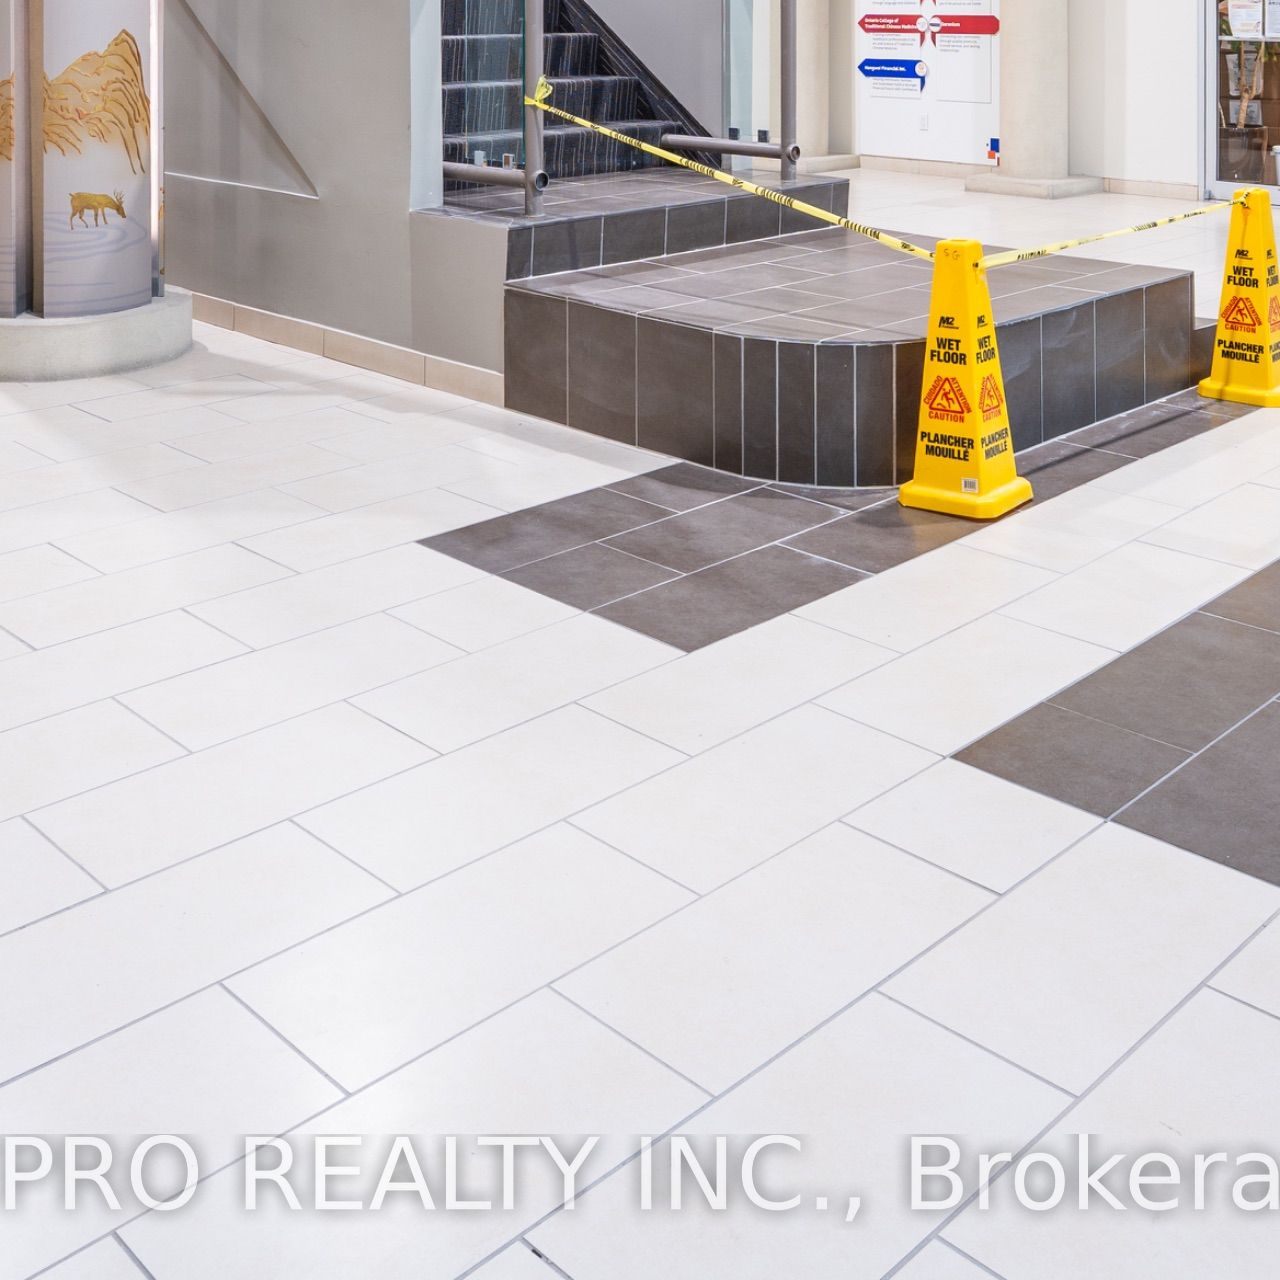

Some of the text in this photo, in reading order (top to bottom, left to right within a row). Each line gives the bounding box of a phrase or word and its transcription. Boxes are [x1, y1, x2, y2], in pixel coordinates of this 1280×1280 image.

[1232, 265, 1254, 277] WET
[1227, 275, 1259, 288] FLOOR
[1225, 323, 1257, 334] CAUTION
[936, 337, 961, 351] WET
[978, 335, 991, 349] WET
[1217, 338, 1264, 354] PLANCHER
[930, 349, 967, 365] FLOOR
[976, 347, 996, 364] FLOOR
[1221, 350, 1260, 363] MOUILLÉ
[923, 375, 943, 405] CUIDADO
[950, 377, 972, 414] ATTENTION
[928, 410, 965, 423] CAUTION
[920, 431, 974, 450] PLANCHER
[980, 427, 1009, 449] PLANCHER
[925, 445, 969, 462] MOUILLÉ
